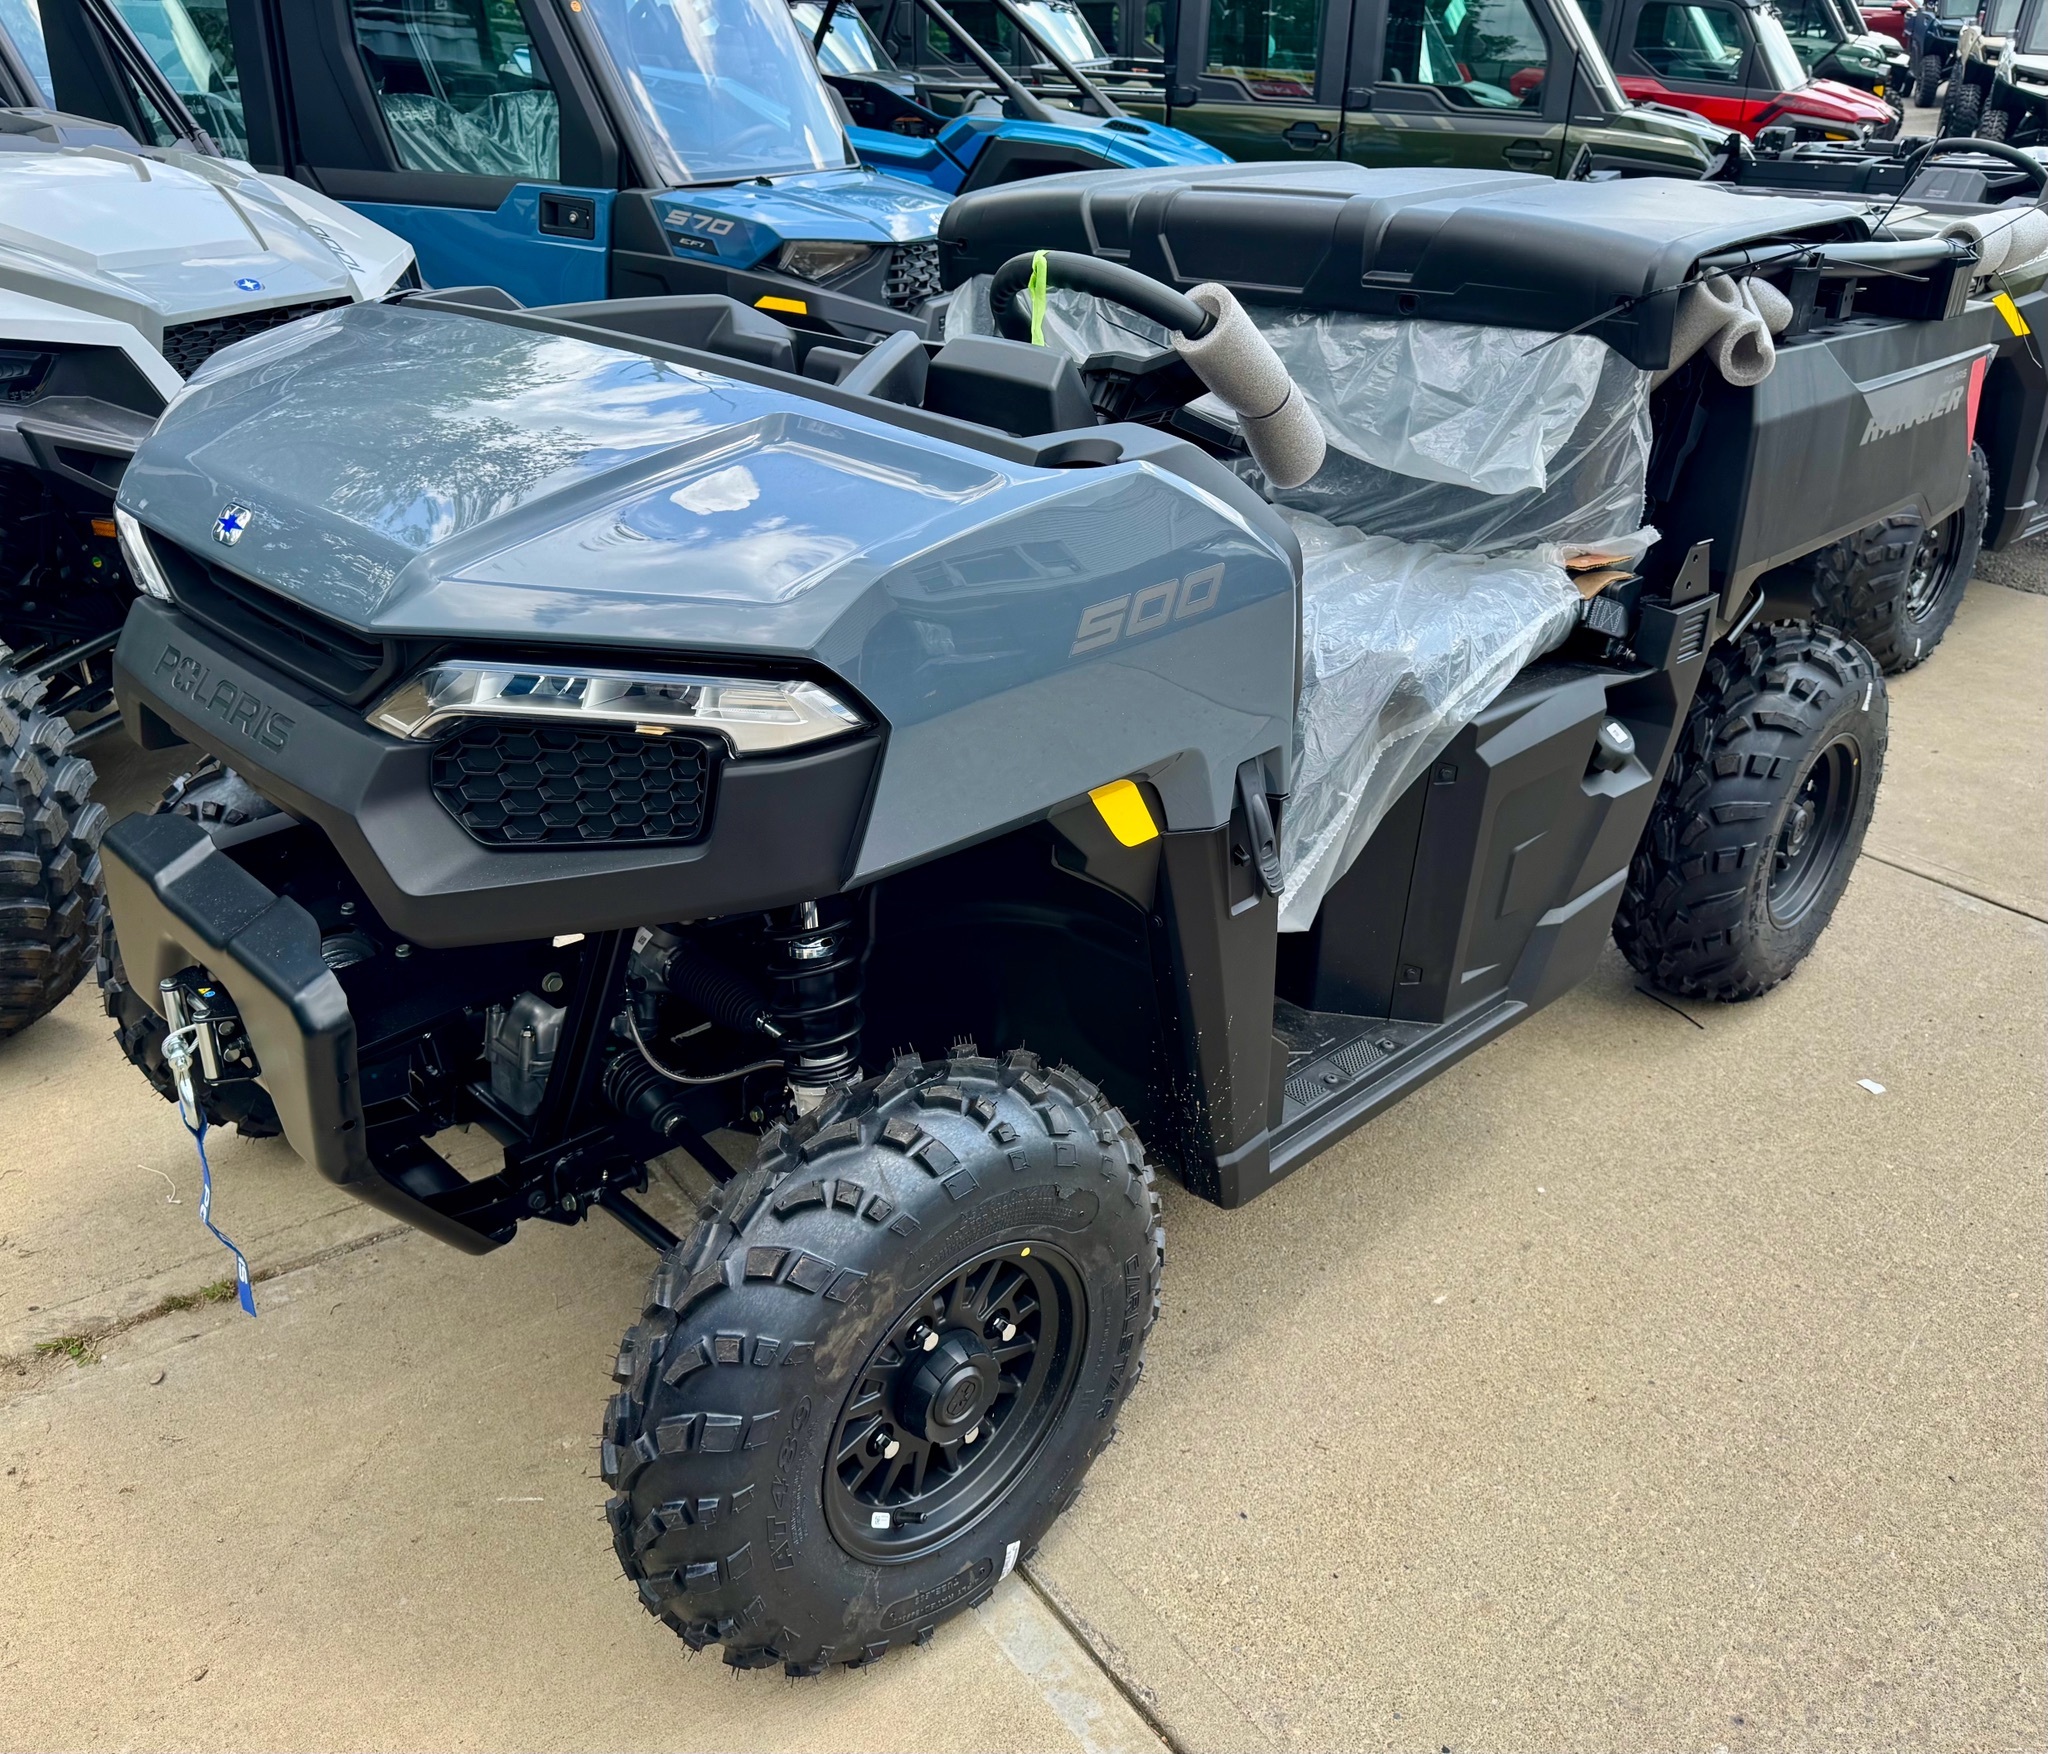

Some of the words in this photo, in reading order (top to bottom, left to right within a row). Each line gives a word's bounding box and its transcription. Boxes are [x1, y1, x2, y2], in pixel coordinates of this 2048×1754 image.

[664, 209, 735, 235] 570
[679, 237, 705, 248] EFI
[1068, 562, 1226, 658] 500
[152, 643, 297, 755] POLARIS
